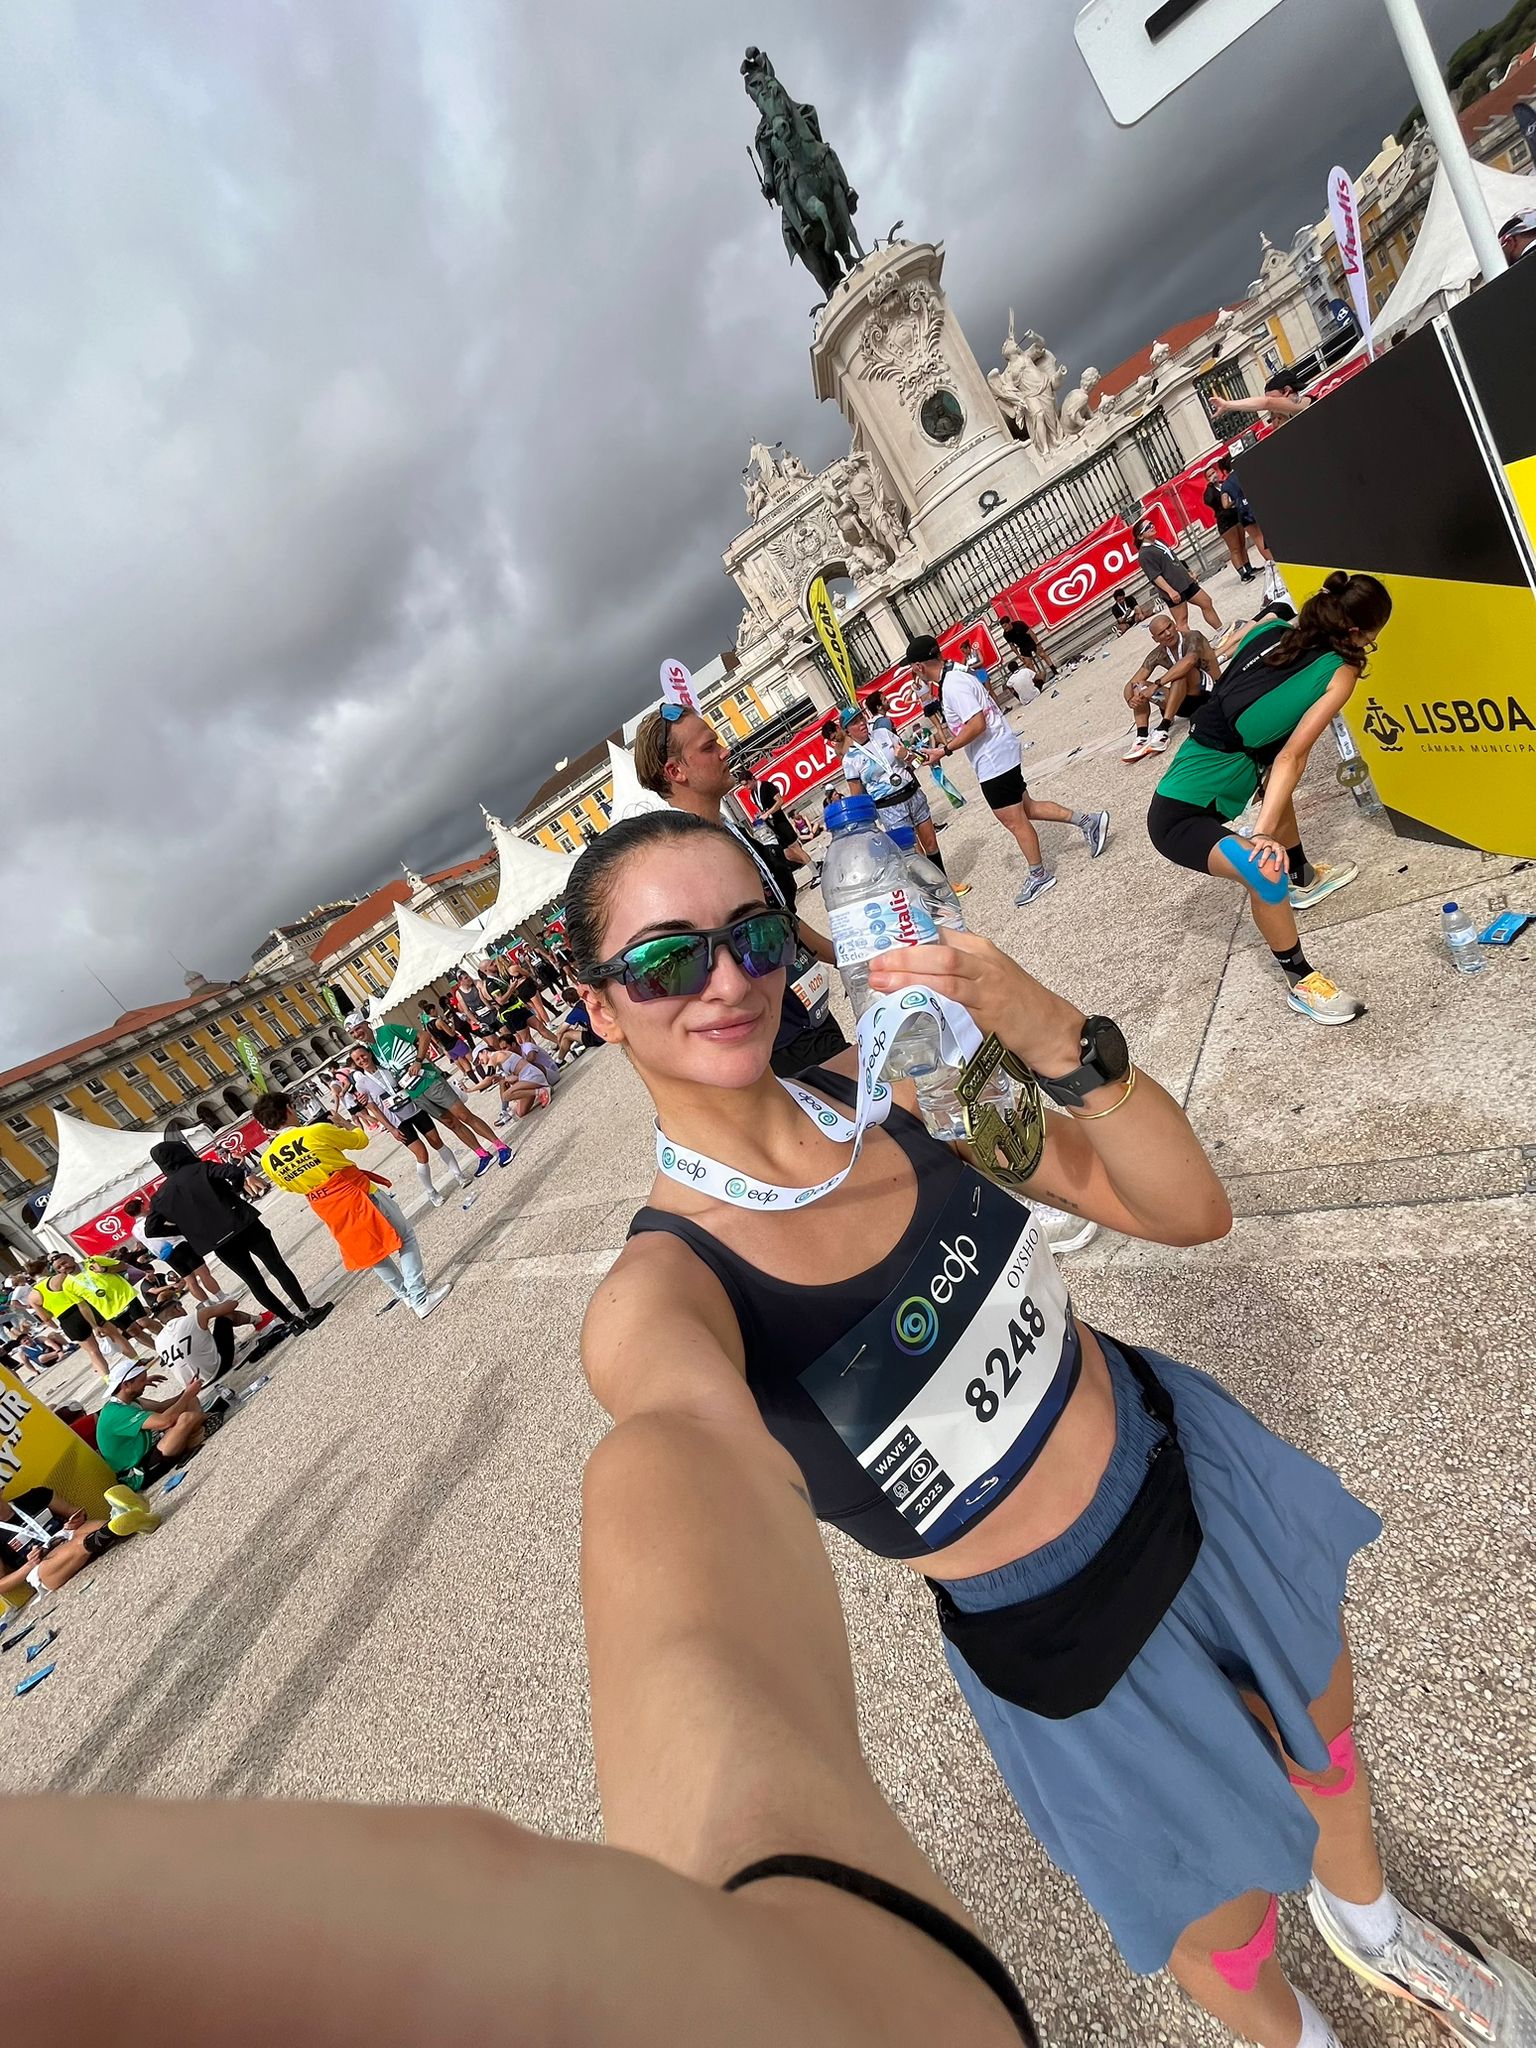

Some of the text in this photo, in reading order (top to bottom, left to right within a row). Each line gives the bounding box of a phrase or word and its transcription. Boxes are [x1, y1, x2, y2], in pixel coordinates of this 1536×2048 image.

[1403, 696, 1536, 735] LISBOA
[868, 1030, 886, 1069] edp
[798, 1090, 822, 1113] edp
[269, 1136, 310, 1172] ASK
[280, 1166, 291, 1176] ME
[296, 1154, 313, 1165] RACE
[284, 1157, 322, 1182] QUESTION
[676, 1159, 707, 1181] edp
[747, 1188, 779, 1205] edp
[930, 1234, 980, 1304] edp
[1006, 1228, 1040, 1289] OYSHO
[965, 1295, 1046, 1423] 8248
[874, 1432, 915, 1476] WAVE 2
[913, 1462, 927, 1479] D
[914, 1482, 944, 1515] 2025
